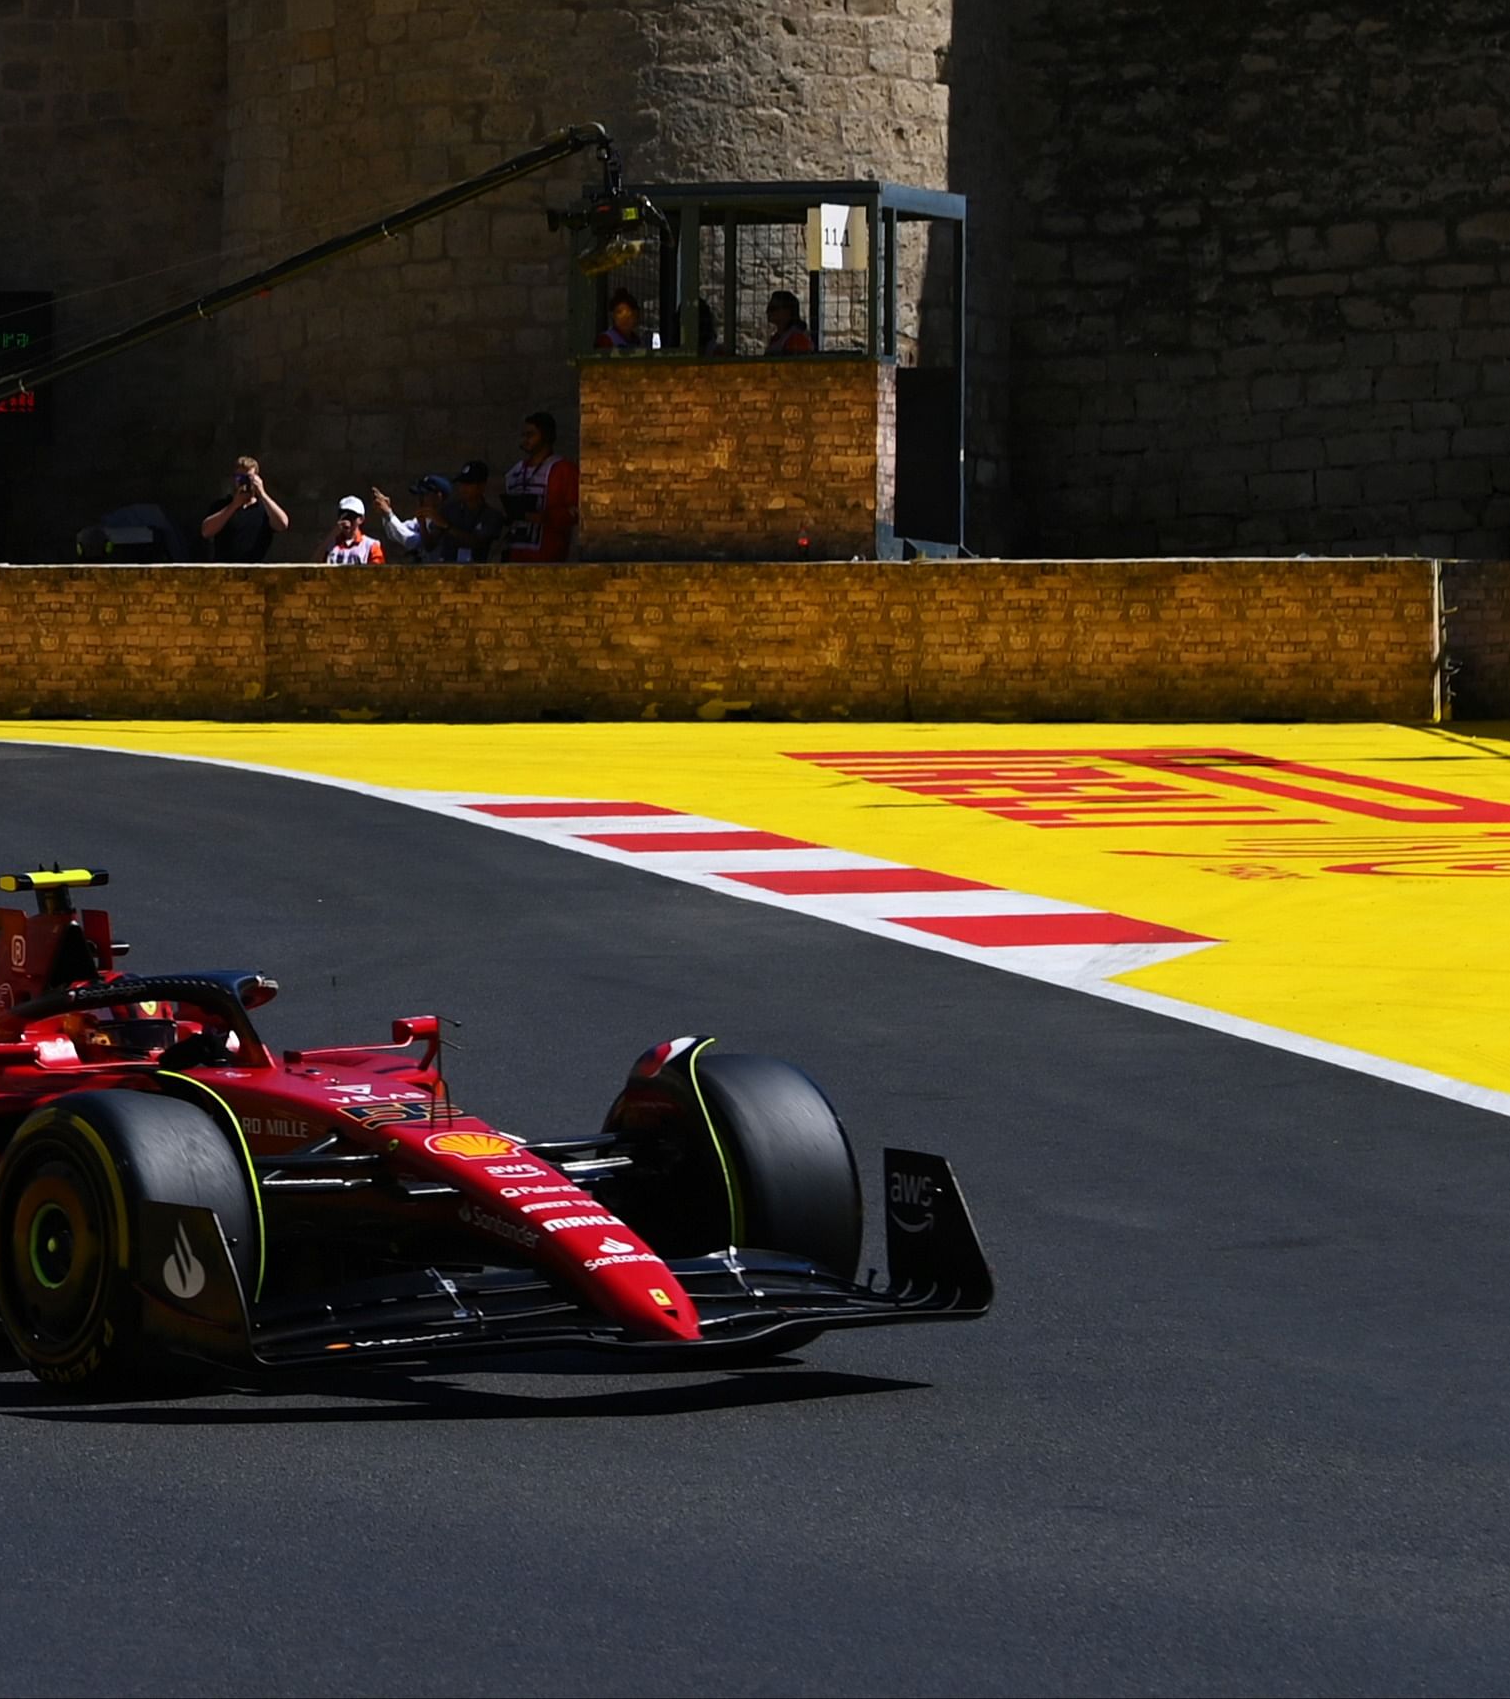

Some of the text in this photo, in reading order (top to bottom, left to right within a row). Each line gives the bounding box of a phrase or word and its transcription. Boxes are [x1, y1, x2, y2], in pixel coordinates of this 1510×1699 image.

[825, 227, 850, 247] 11.1
[265, 1117, 309, 1139] MILLE
[484, 1163, 539, 1176] aws
[890, 1171, 933, 1207] aws
